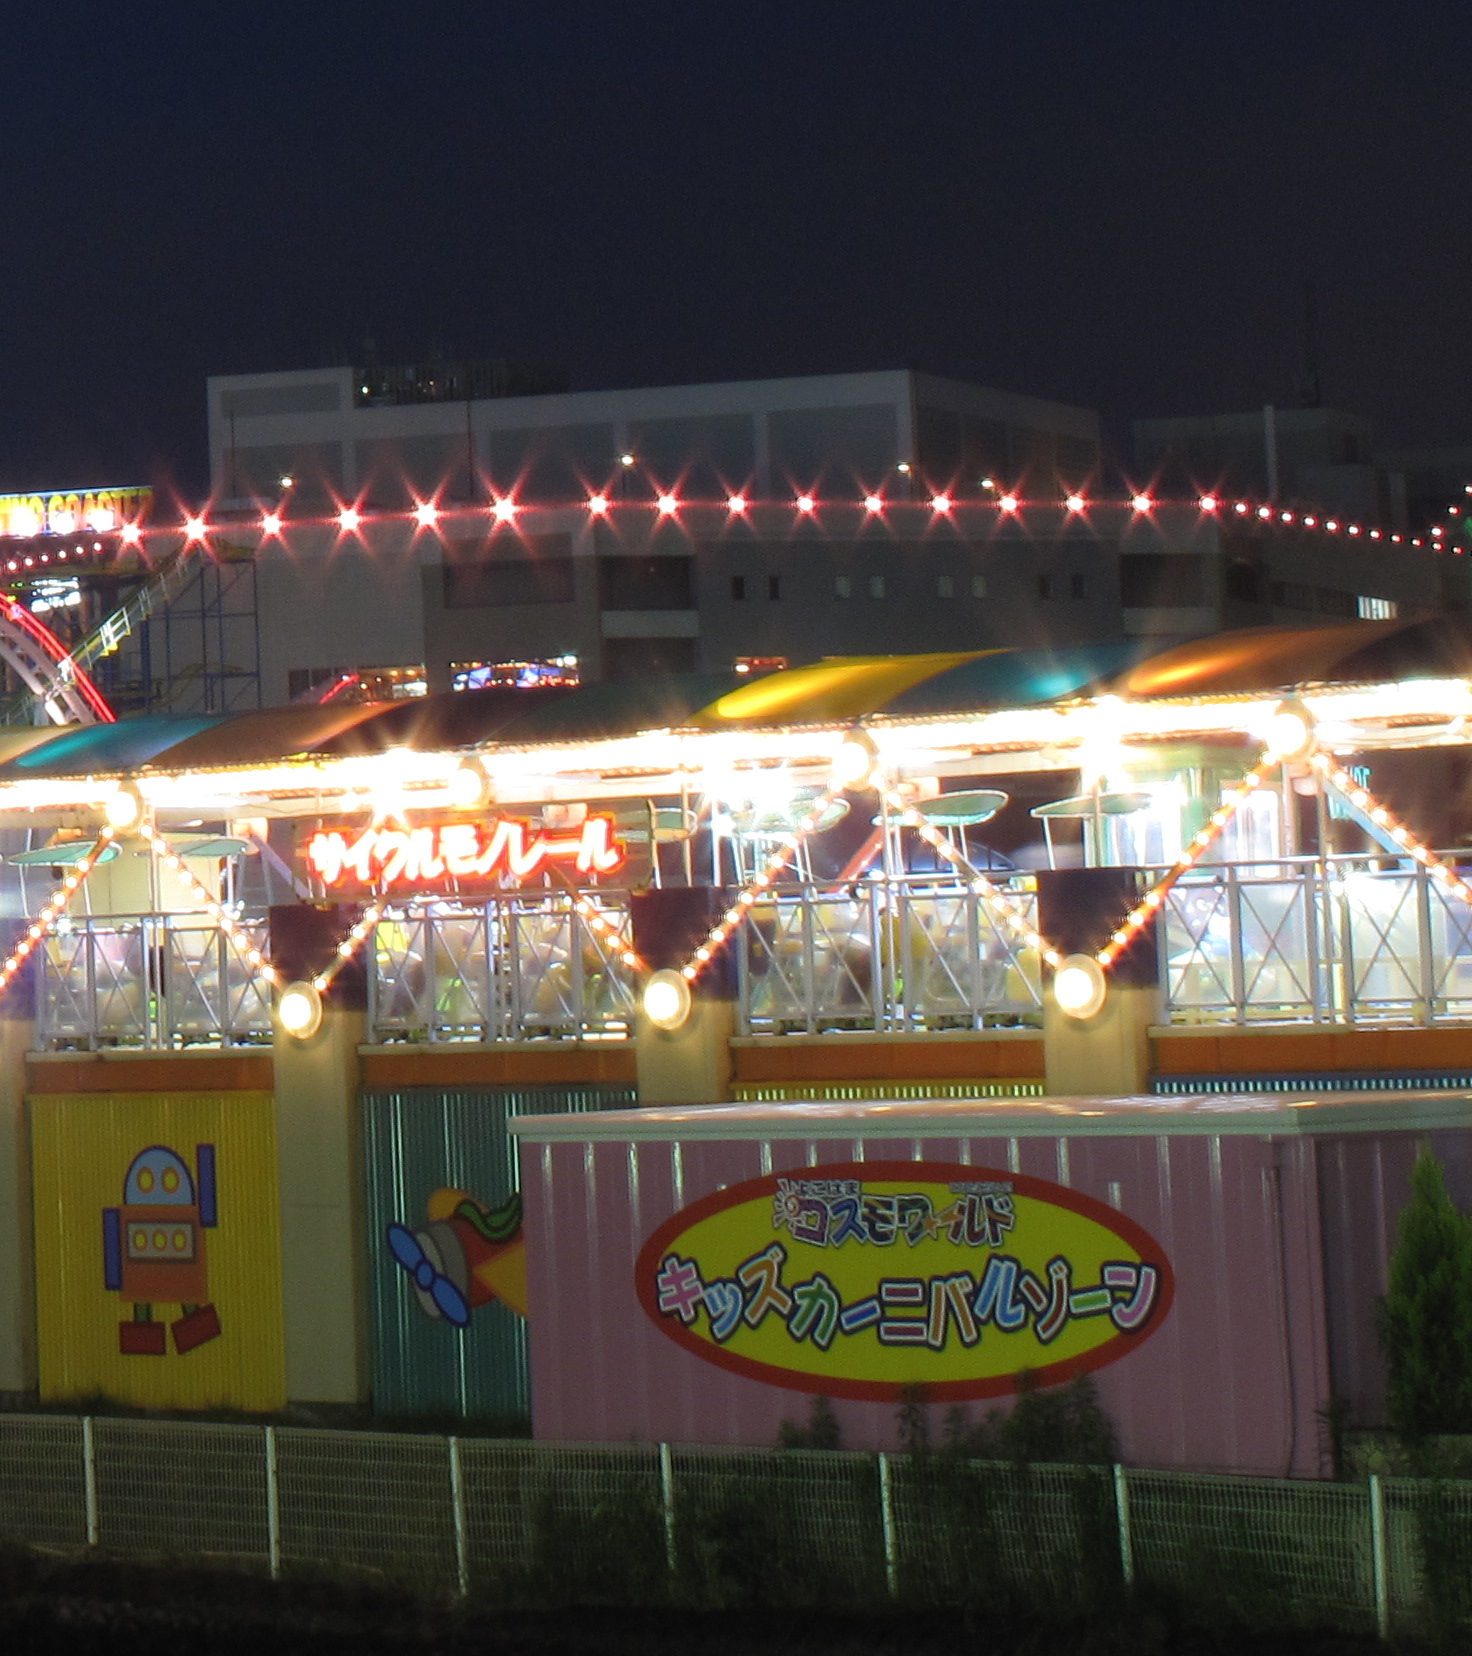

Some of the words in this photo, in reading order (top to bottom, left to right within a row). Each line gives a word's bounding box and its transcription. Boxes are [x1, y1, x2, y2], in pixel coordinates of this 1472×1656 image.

[309, 816, 622, 885] サイクルモノレール
[658, 1244, 1158, 1349] キッズカーニバルゾーン
